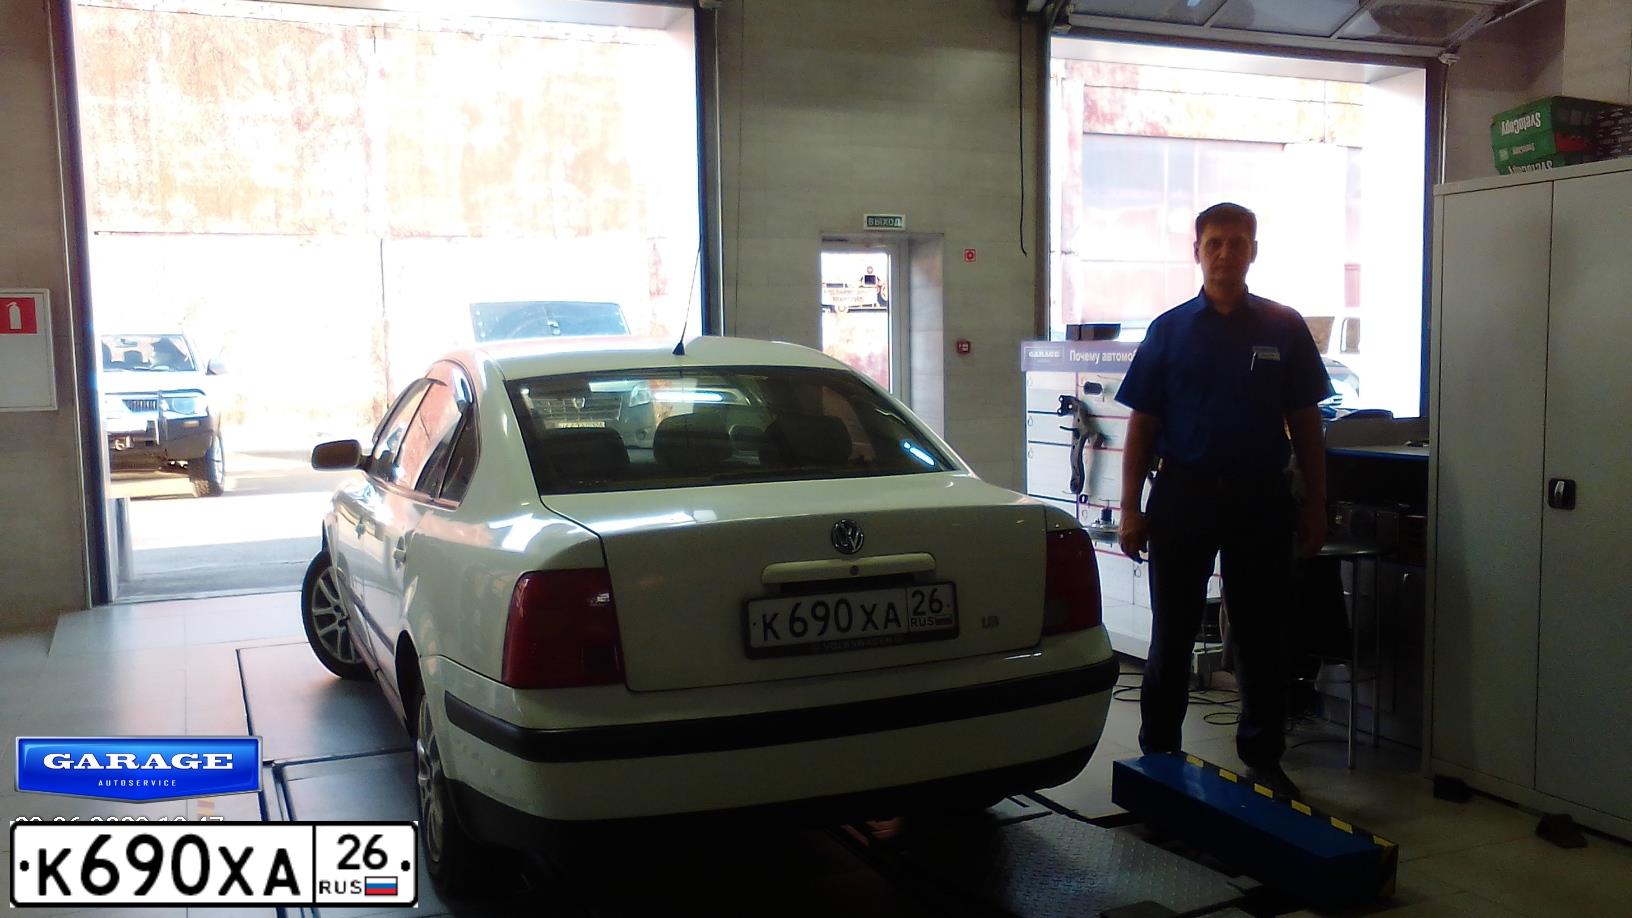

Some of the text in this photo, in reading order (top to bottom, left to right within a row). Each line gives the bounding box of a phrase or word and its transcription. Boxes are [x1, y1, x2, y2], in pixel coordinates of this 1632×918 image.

[1501, 112, 1541, 136] SvetoCopy
[868, 217, 902, 227] ВЫХОД
[1069, 350, 1100, 364] Почему
[911, 588, 943, 616] 26
[910, 616, 935, 628] RUS
